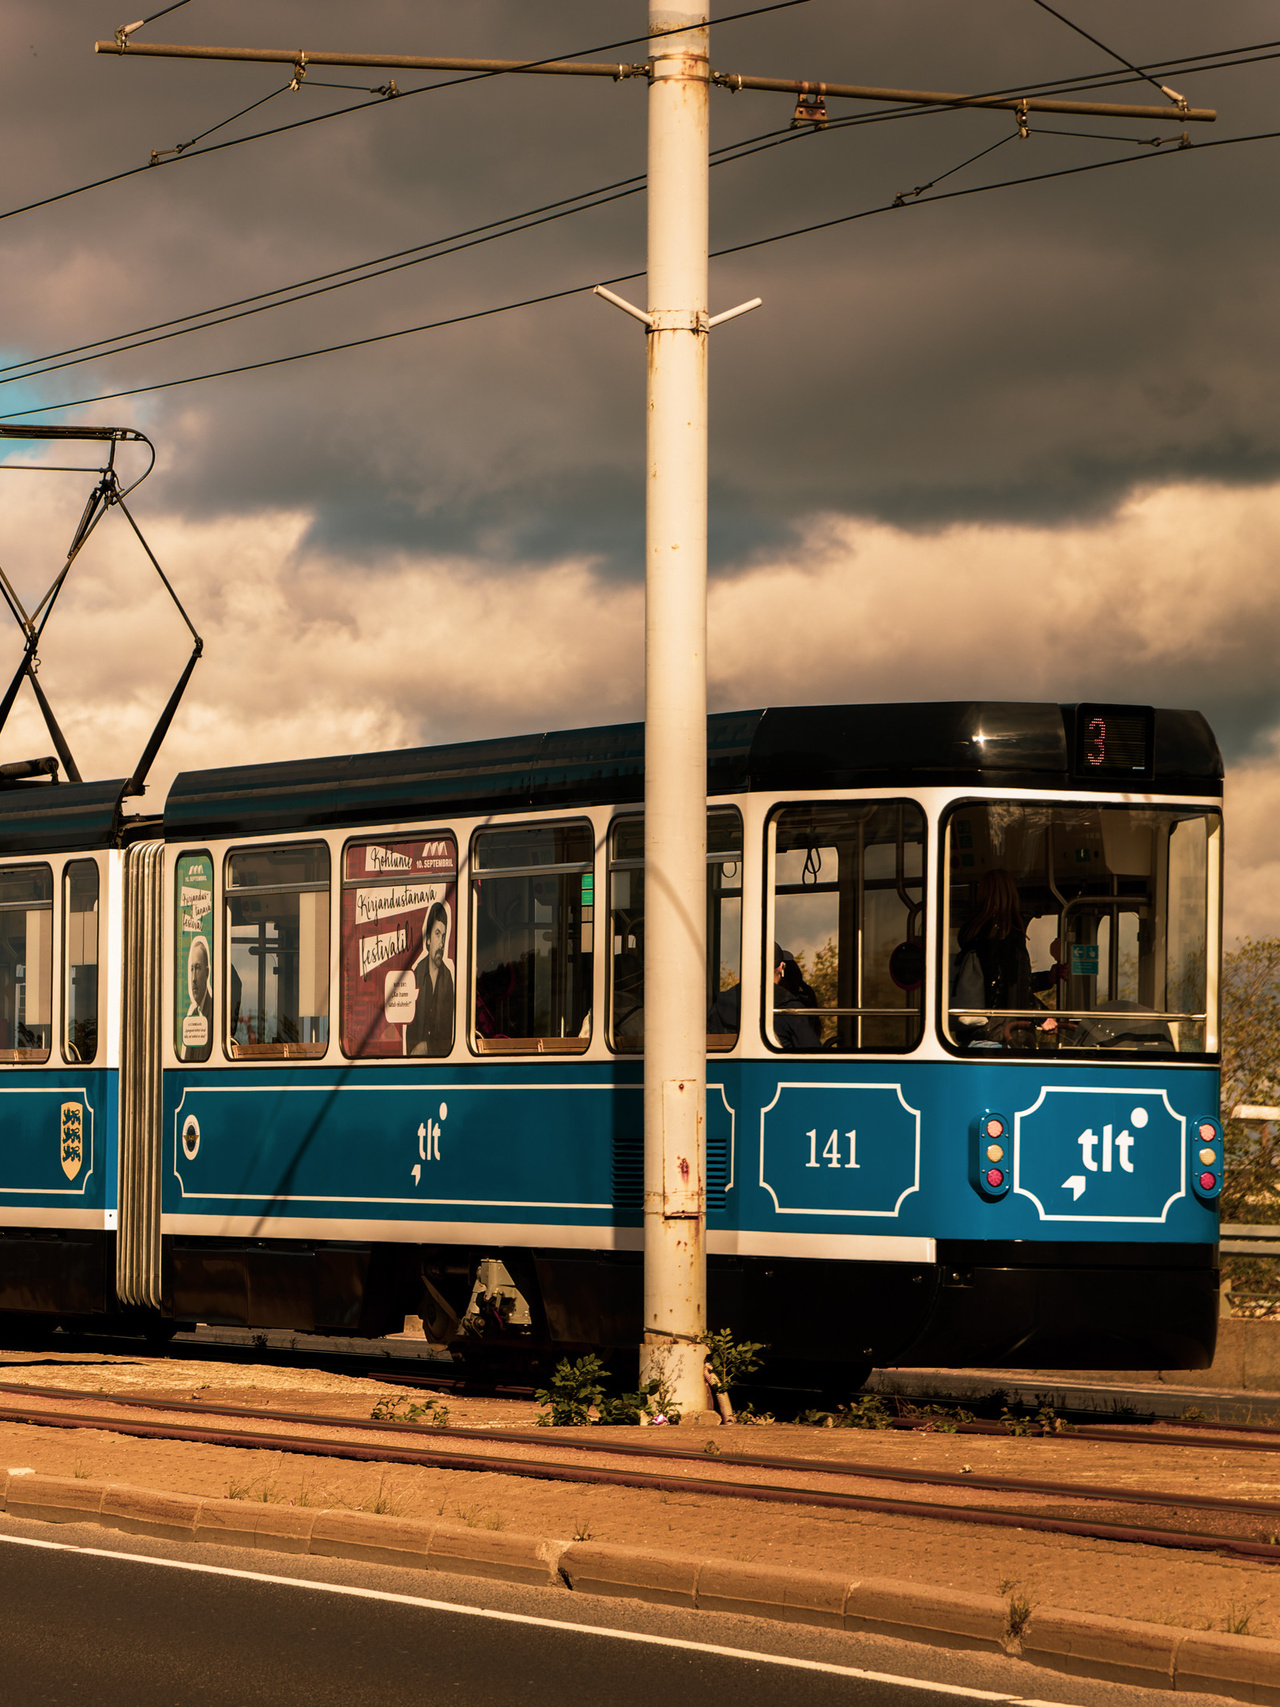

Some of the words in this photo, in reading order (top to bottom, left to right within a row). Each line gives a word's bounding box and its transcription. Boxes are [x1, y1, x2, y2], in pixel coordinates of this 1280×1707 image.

[1087, 717, 1106, 766] 3
[416, 860, 424, 869] 10.
[424, 858, 454, 869] SEPTEMBRIL
[417, 1117, 441, 1161] tlt
[805, 1128, 861, 1168] 141
[1077, 1123, 1135, 1173] tlt
